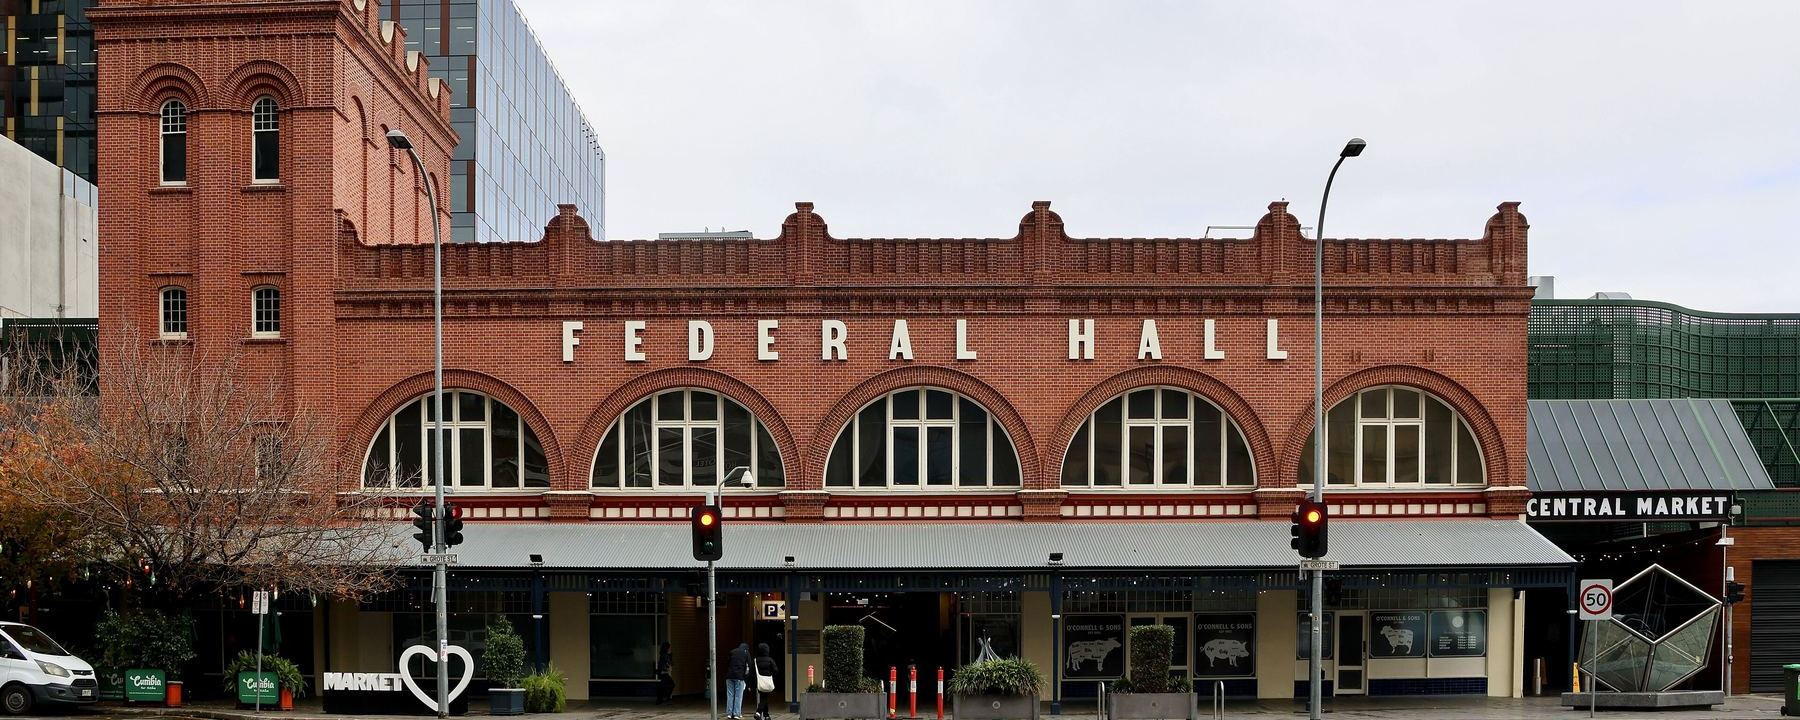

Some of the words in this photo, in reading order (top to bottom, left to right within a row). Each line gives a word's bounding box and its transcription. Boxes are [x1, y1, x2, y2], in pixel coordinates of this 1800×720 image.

[562, 318, 977, 362] FEDERAL
[1068, 318, 1288, 360] HALL
[1526, 497, 1626, 517] CENTRAL
[1637, 496, 1728, 515] MARKET
[429, 555, 446, 563] GROTE
[1310, 561, 1327, 569] GROTE
[1586, 592, 1606, 607] 50
[767, 605, 776, 616] P
[1066, 624, 1099, 632] O'CONNELL
[1105, 624, 1121, 632] SONS
[1197, 623, 1229, 631] O'CONNELL
[1236, 623, 1253, 631] SONS
[129, 674, 162, 687] Cumbia
[242, 677, 275, 690] Cumbia
[323, 671, 403, 692] MARKET
